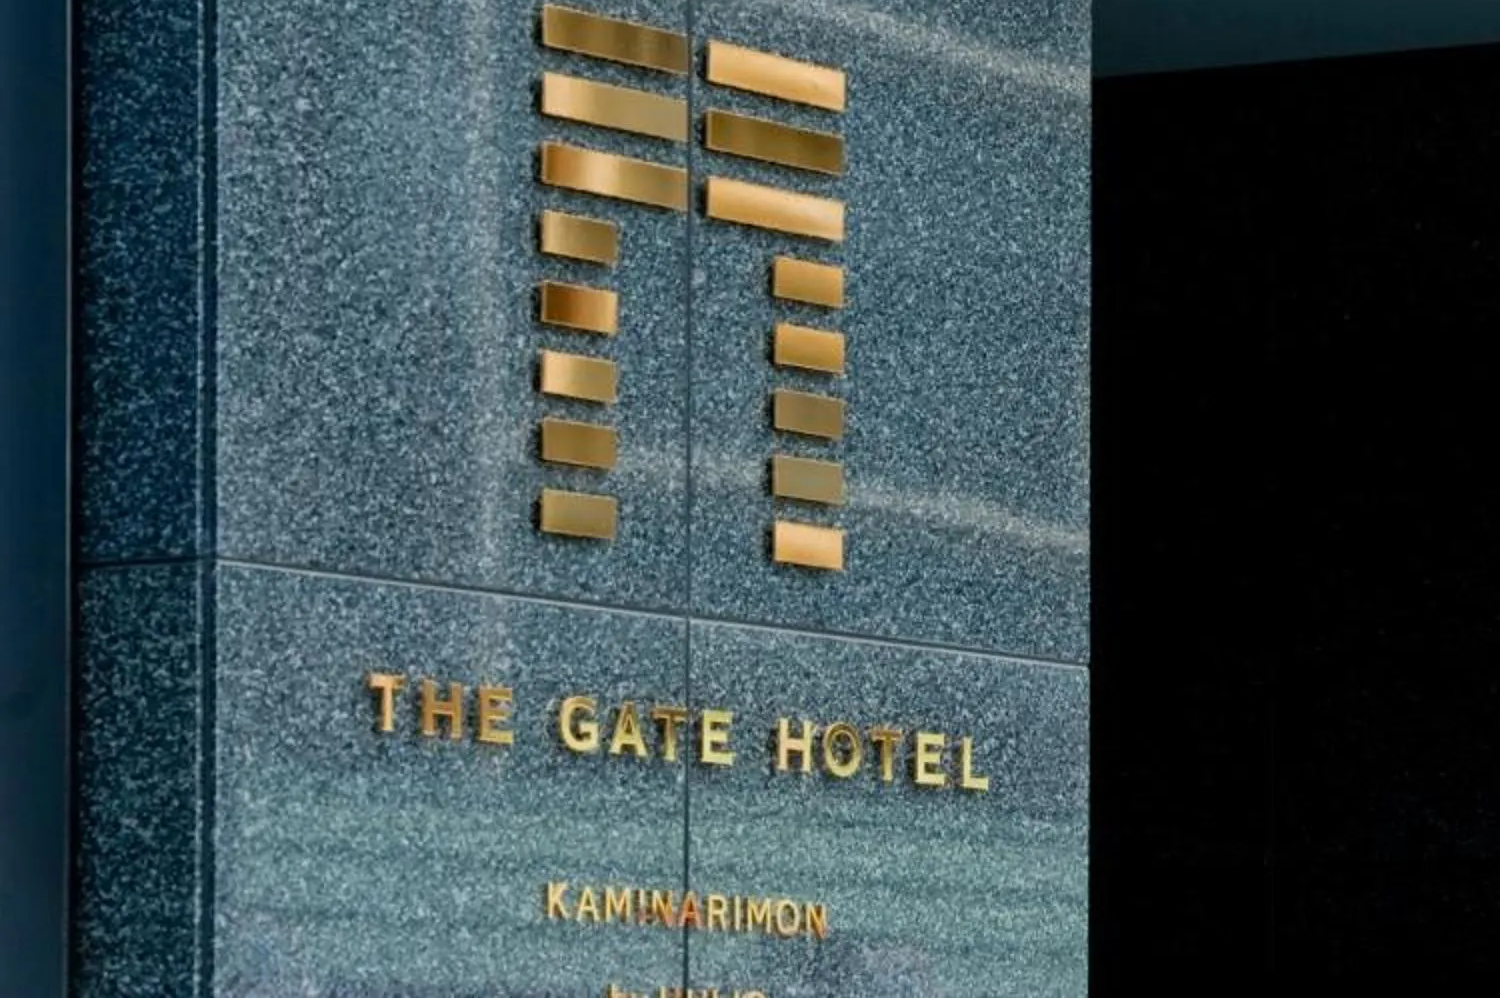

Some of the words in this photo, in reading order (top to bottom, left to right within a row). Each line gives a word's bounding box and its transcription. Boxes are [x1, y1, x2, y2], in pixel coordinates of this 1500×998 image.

[367, 672, 514, 745] THE
[558, 695, 736, 766] GATE
[776, 716, 990, 791] HOTEL
[546, 881, 829, 939] KAMINARIMON
